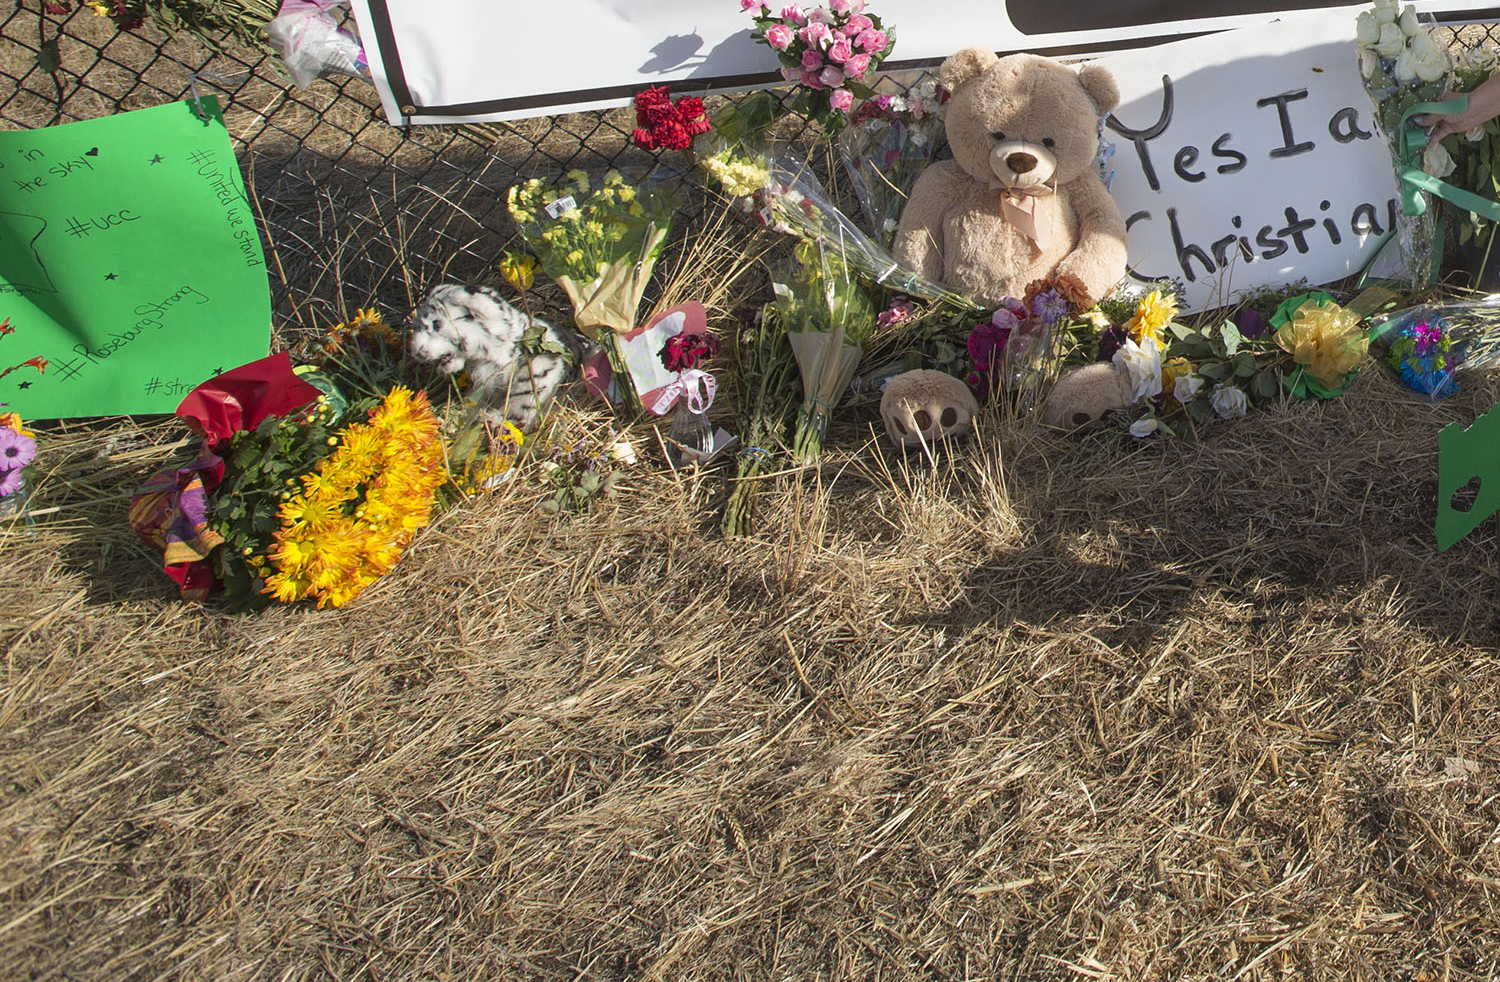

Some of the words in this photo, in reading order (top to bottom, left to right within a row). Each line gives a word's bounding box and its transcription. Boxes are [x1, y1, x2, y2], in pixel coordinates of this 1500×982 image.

[1105, 74, 1248, 192] Yes
[1256, 88, 1316, 159] I
[1328, 106, 1381, 144] a
[13, 176, 49, 194] the
